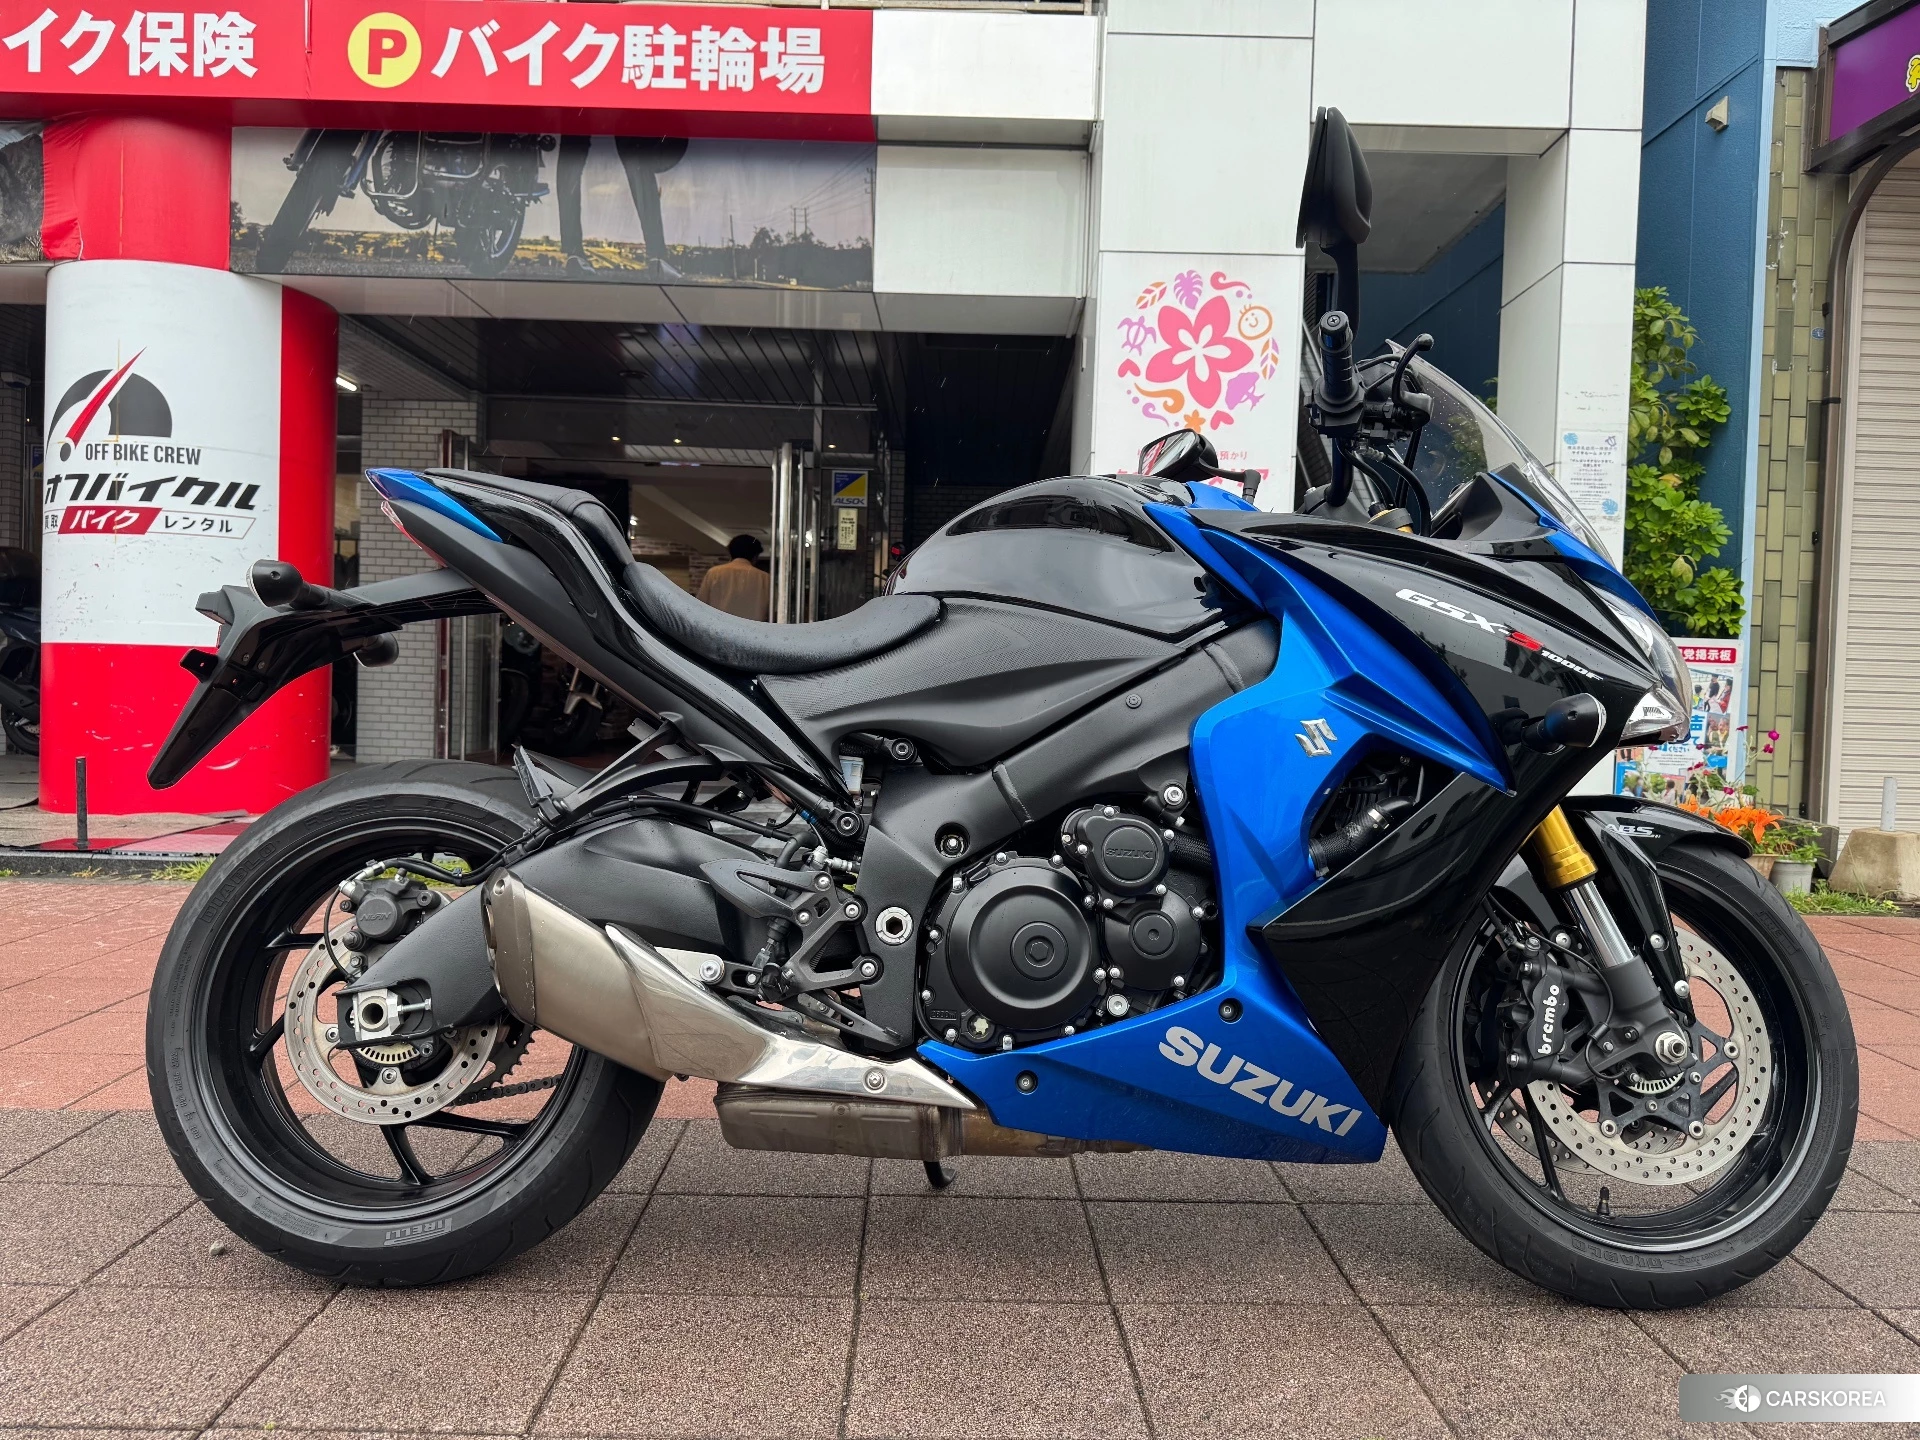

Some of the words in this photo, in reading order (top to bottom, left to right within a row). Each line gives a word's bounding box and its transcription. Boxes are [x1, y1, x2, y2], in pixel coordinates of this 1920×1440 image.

[3, 8, 258, 78] イク保険
[431, 19, 826, 95] バイク駐輪場
[85, 442, 109, 461] OFF
[112, 443, 149, 462] BIKE
[153, 444, 202, 466] CREW
[1218, 450, 1248, 460] 預かり
[44, 472, 262, 511] オフバイクル
[833, 497, 865, 505] ALSOK
[69, 509, 140, 531] バイク
[164, 515, 233, 533] レンタル
[1541, 649, 1605, 681] 1000F
[1679, 648, 1732, 661] 党掲示板
[1605, 823, 1655, 837] ABS
[1105, 847, 1154, 860] SUZUKI
[199, 840, 278, 924] DIABLO
[1537, 984, 1560, 1056] brembo
[1158, 1025, 1363, 1137] SUZUKI
[383, 1217, 453, 1246] PIRELLI
